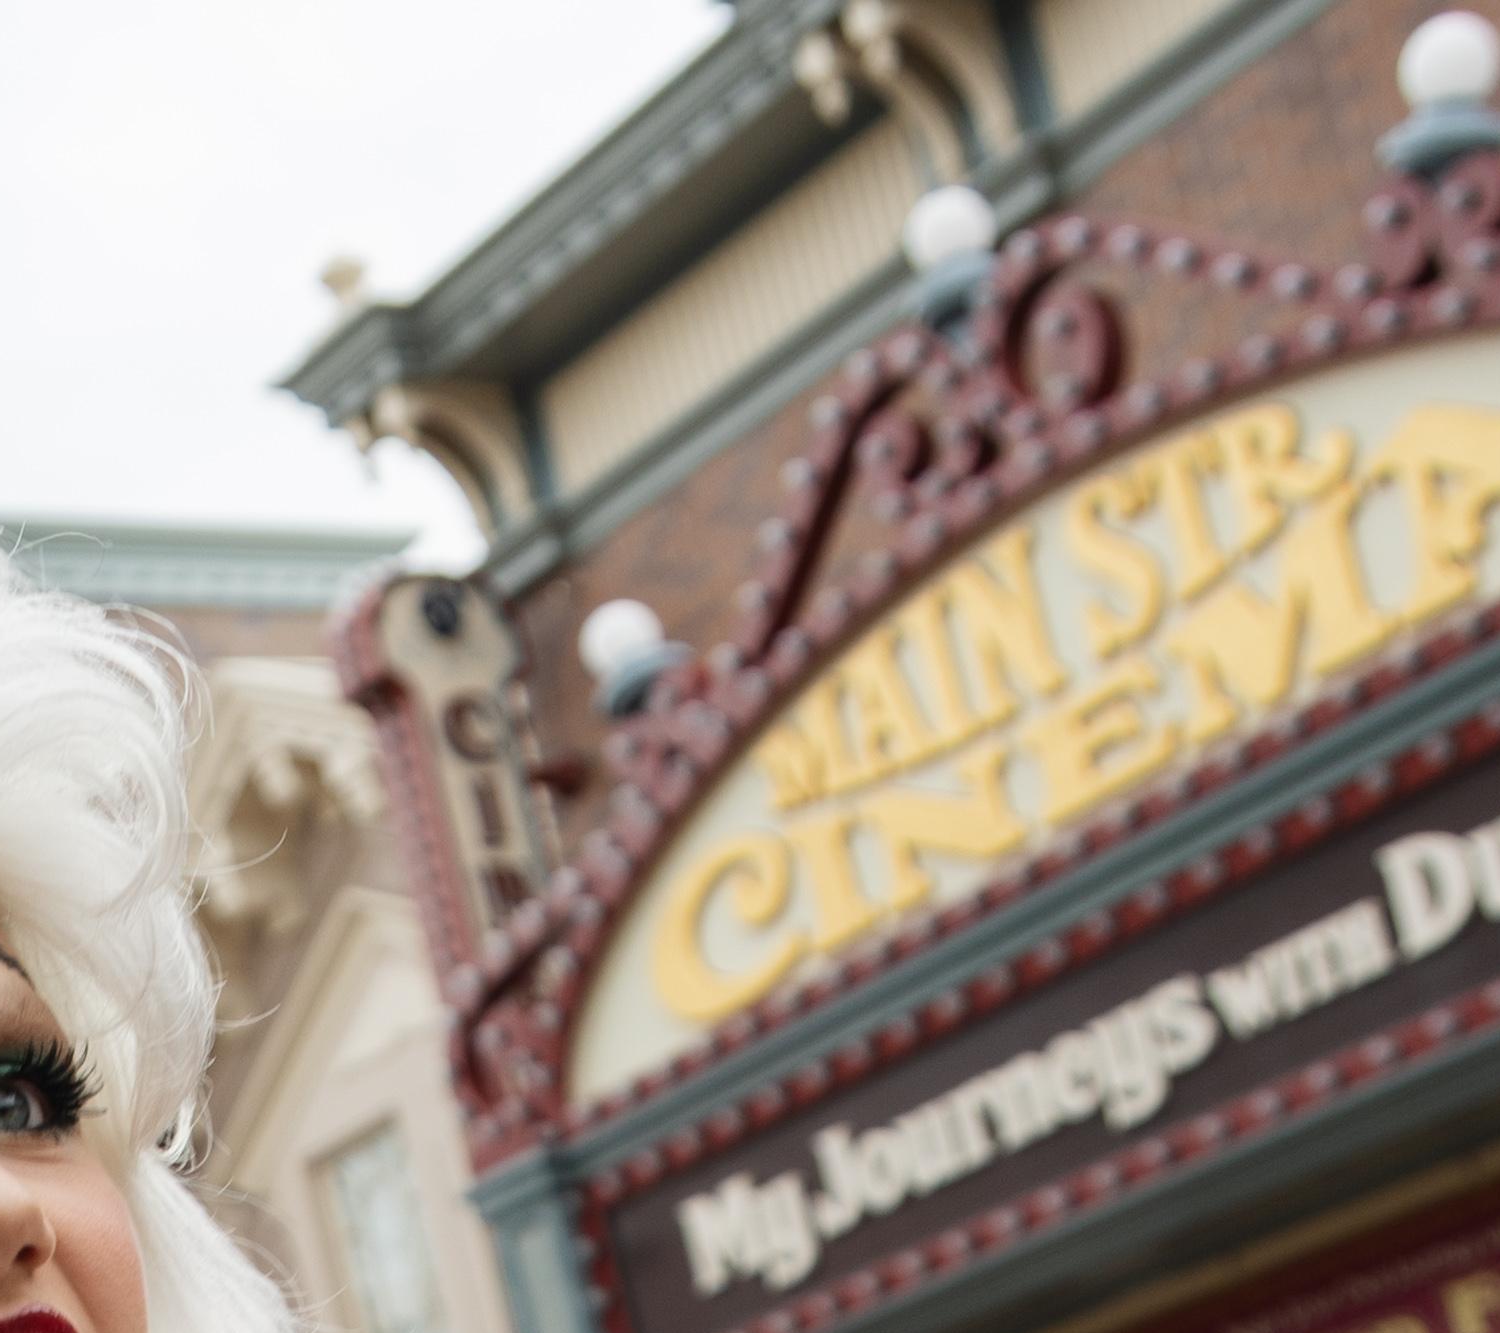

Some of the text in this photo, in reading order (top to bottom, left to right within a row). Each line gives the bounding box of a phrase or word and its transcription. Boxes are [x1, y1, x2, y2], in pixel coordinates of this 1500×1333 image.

[755, 521, 1069, 808] MAIN
[677, 1168, 820, 1296] My
[810, 972, 1220, 1241] Journeys
